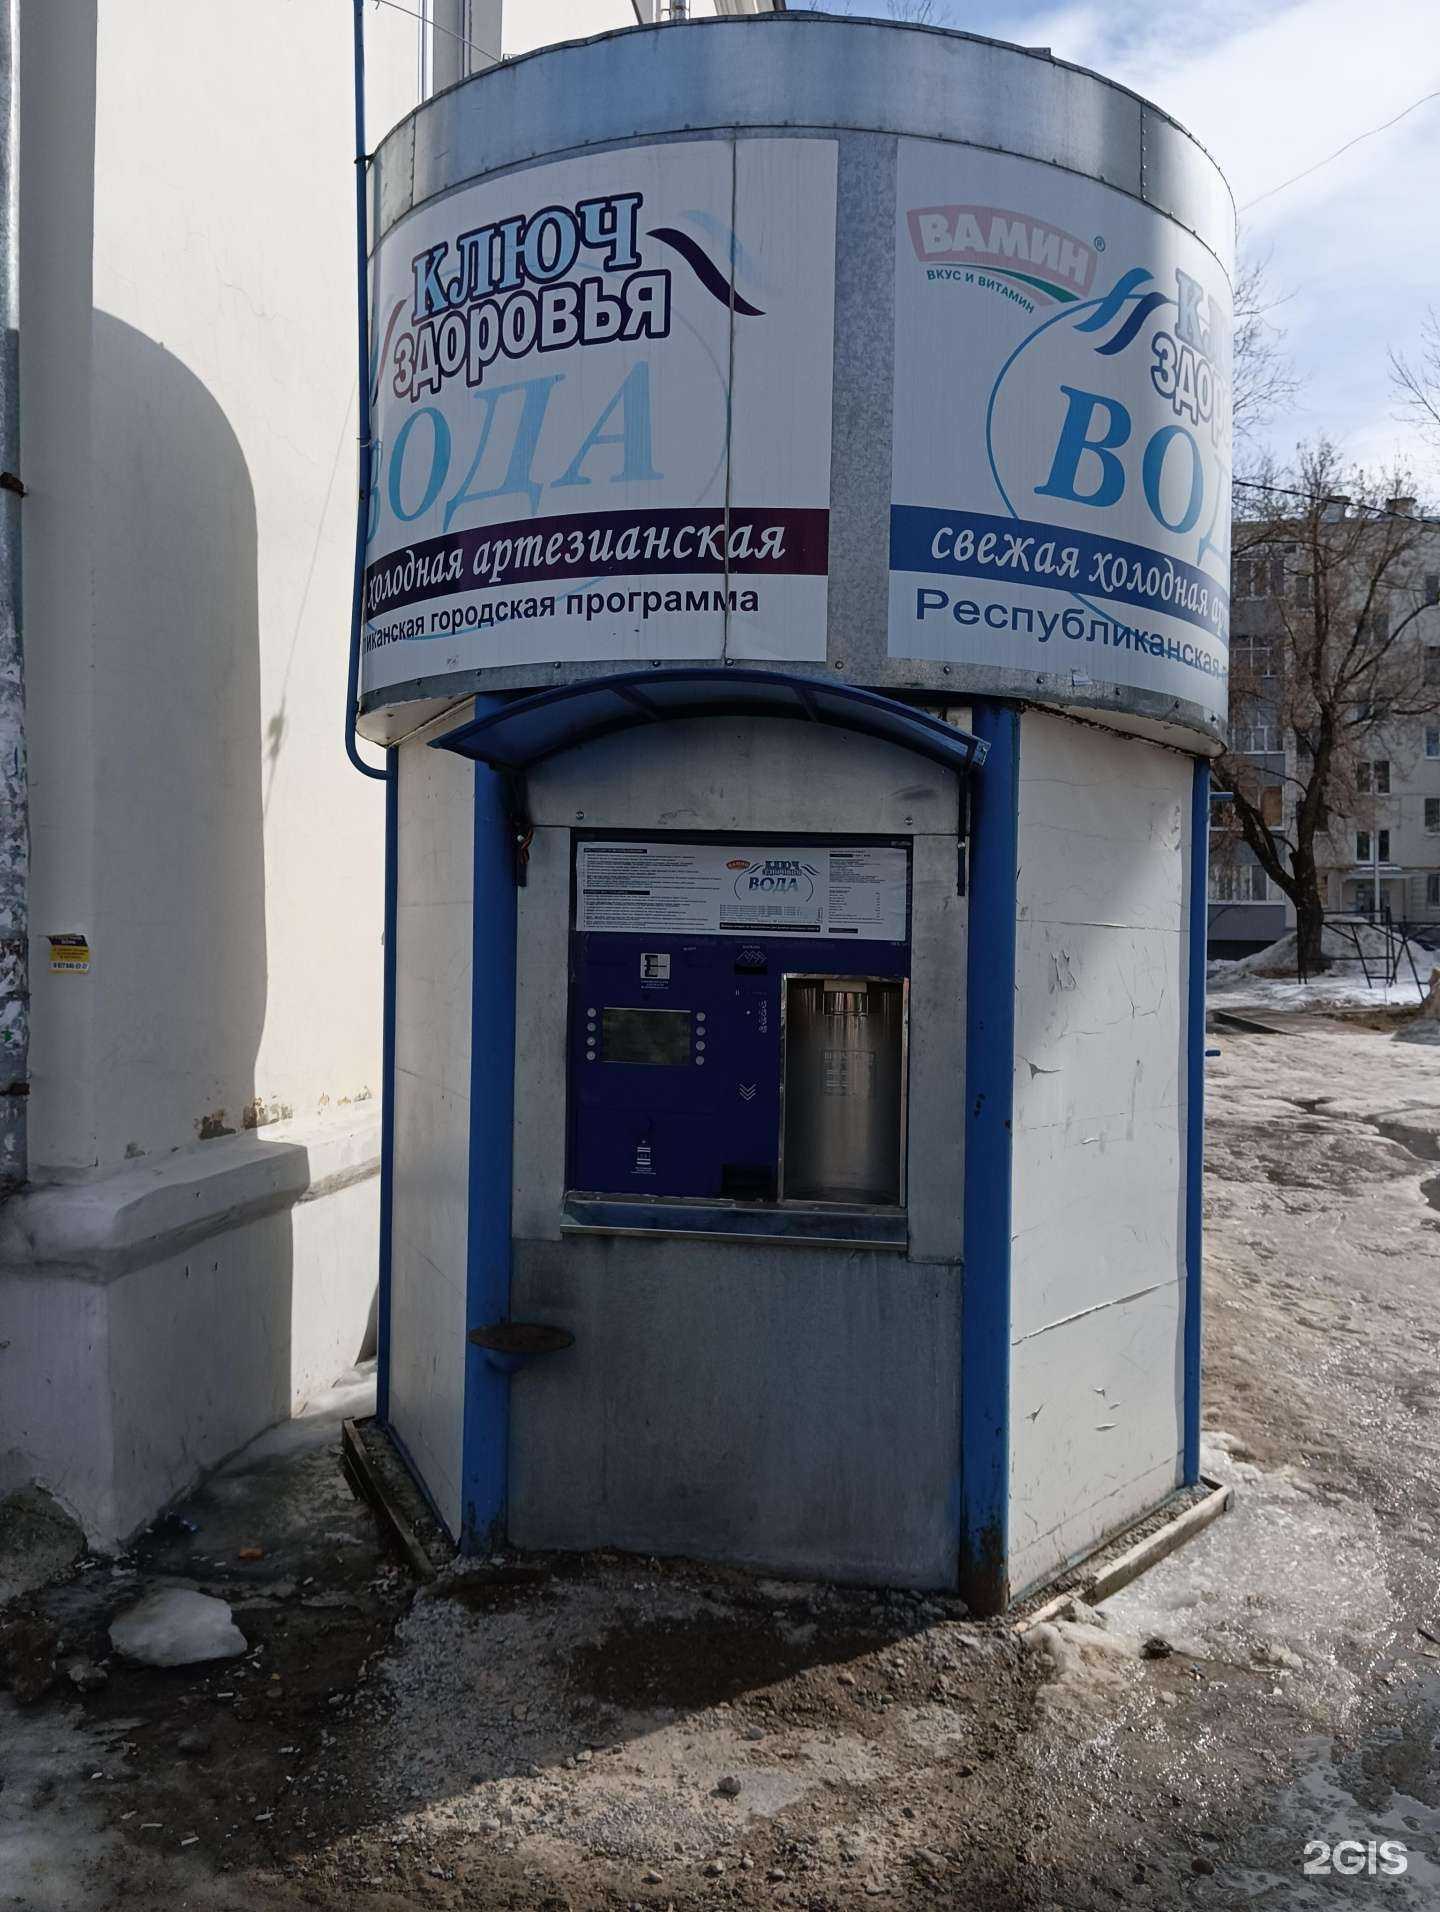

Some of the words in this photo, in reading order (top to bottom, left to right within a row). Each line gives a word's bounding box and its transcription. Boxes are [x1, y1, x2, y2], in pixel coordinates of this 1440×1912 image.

[412, 192, 643, 323] КЛЮЧ
[917, 213, 1090, 286] ВАМИН
[926, 269, 962, 281] ВКУС
[965, 273, 975, 283] И
[977, 276, 1036, 315] ВИТАМИН
[367, 550, 464, 612] холодная
[473, 520, 787, 583] артезианская
[931, 525, 1081, 579] свежая
[1088, 552, 1209, 617] холодная
[431, 596, 556, 635] городская
[566, 588, 760, 621] программа
[916, 589, 1220, 675] Республиканская
